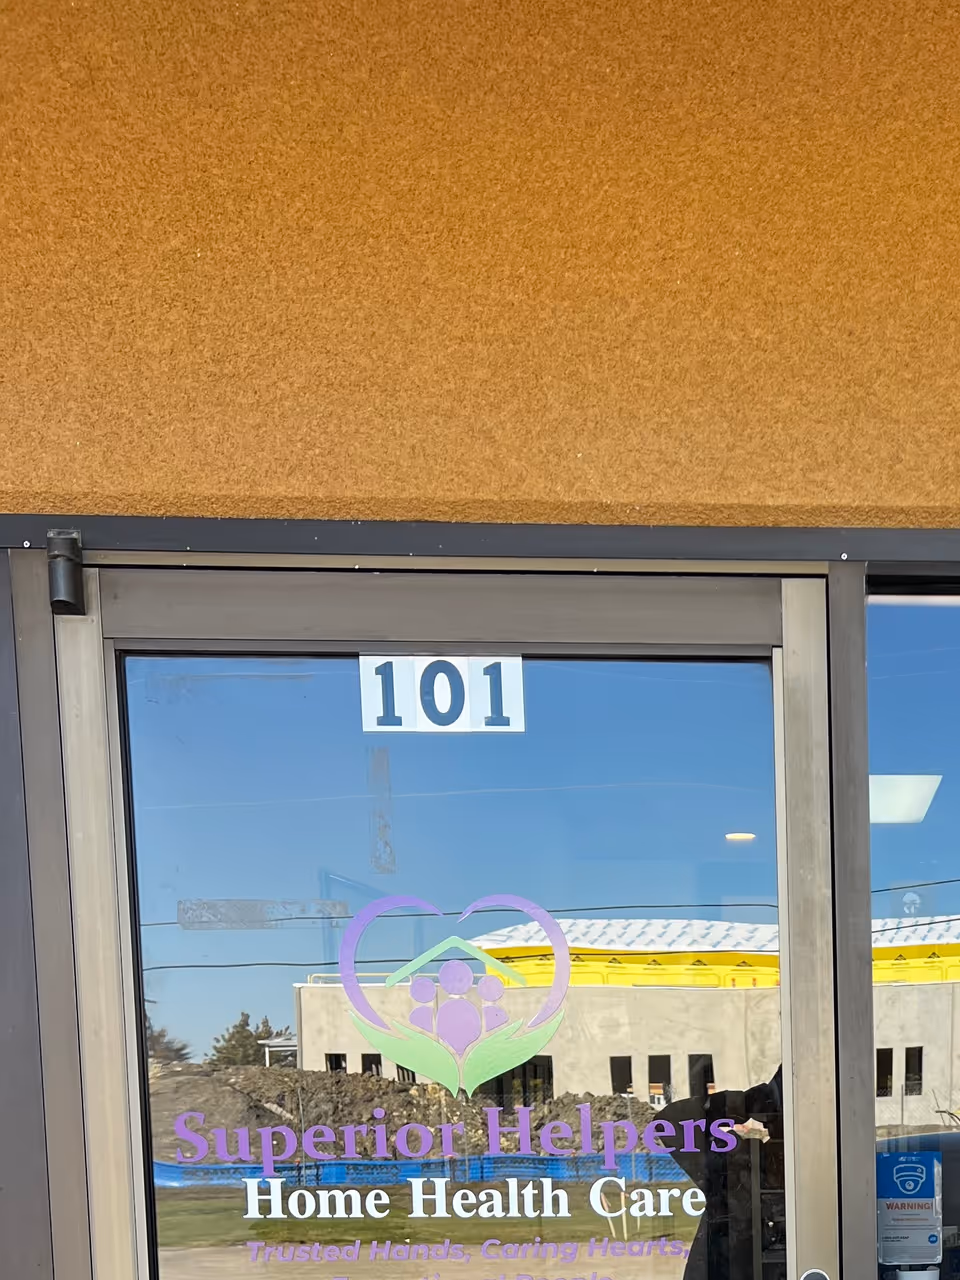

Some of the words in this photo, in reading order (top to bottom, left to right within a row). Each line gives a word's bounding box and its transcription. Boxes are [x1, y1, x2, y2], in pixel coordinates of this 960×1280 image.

[373, 659, 511, 727] 101
[174, 1105, 465, 1176] Superior
[483, 1103, 739, 1170] Helpers
[241, 1178, 390, 1219] Home
[407, 1177, 572, 1218] Health
[589, 1176, 707, 1218] Care
[246, 1240, 361, 1262] Trusted
[369, 1238, 472, 1264] Hands,
[481, 1238, 578, 1264] Caring
[587, 1236, 690, 1260] Hearts,
